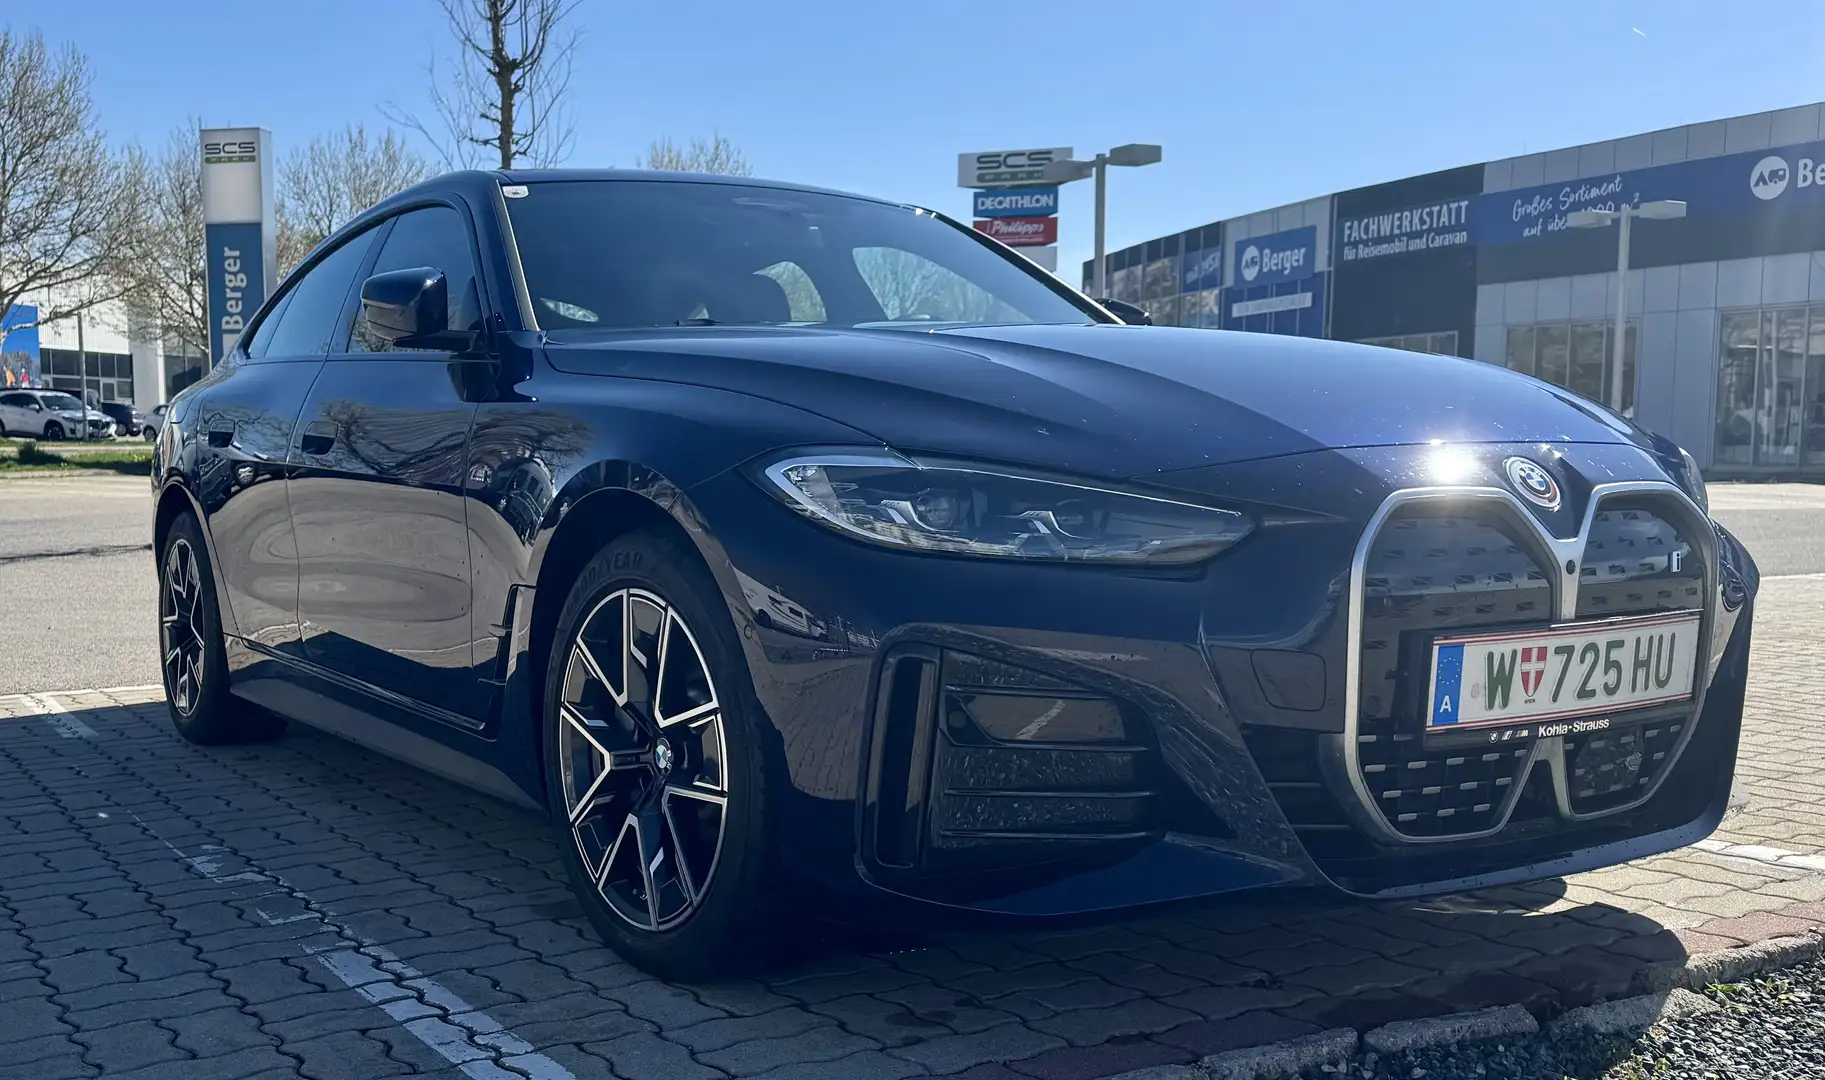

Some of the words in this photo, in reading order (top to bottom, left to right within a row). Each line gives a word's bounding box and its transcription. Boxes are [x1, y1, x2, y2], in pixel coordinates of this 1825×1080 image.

[204, 142, 256, 155] SCS
[976, 150, 1053, 171] SCS
[977, 193, 1054, 210] DECATHLON
[1512, 195, 1553, 222] Großes
[1559, 174, 1623, 210] Sortiment
[1343, 200, 1469, 243] FACHWERKSTATT
[1523, 218, 1543, 237] auf
[1547, 213, 1568, 232] übe
[1343, 246, 1356, 261] für
[1357, 236, 1407, 259] Reisemobil
[1408, 232, 1427, 251] und
[1428, 231, 1468, 248] Caravan
[1262, 247, 1306, 275] Berger
[221, 246, 247, 331] Berger
[1486, 649, 1518, 711] W
[1551, 639, 1625, 703] 725
[1631, 632, 1677, 694] HU
[1439, 695, 1452, 713] A
